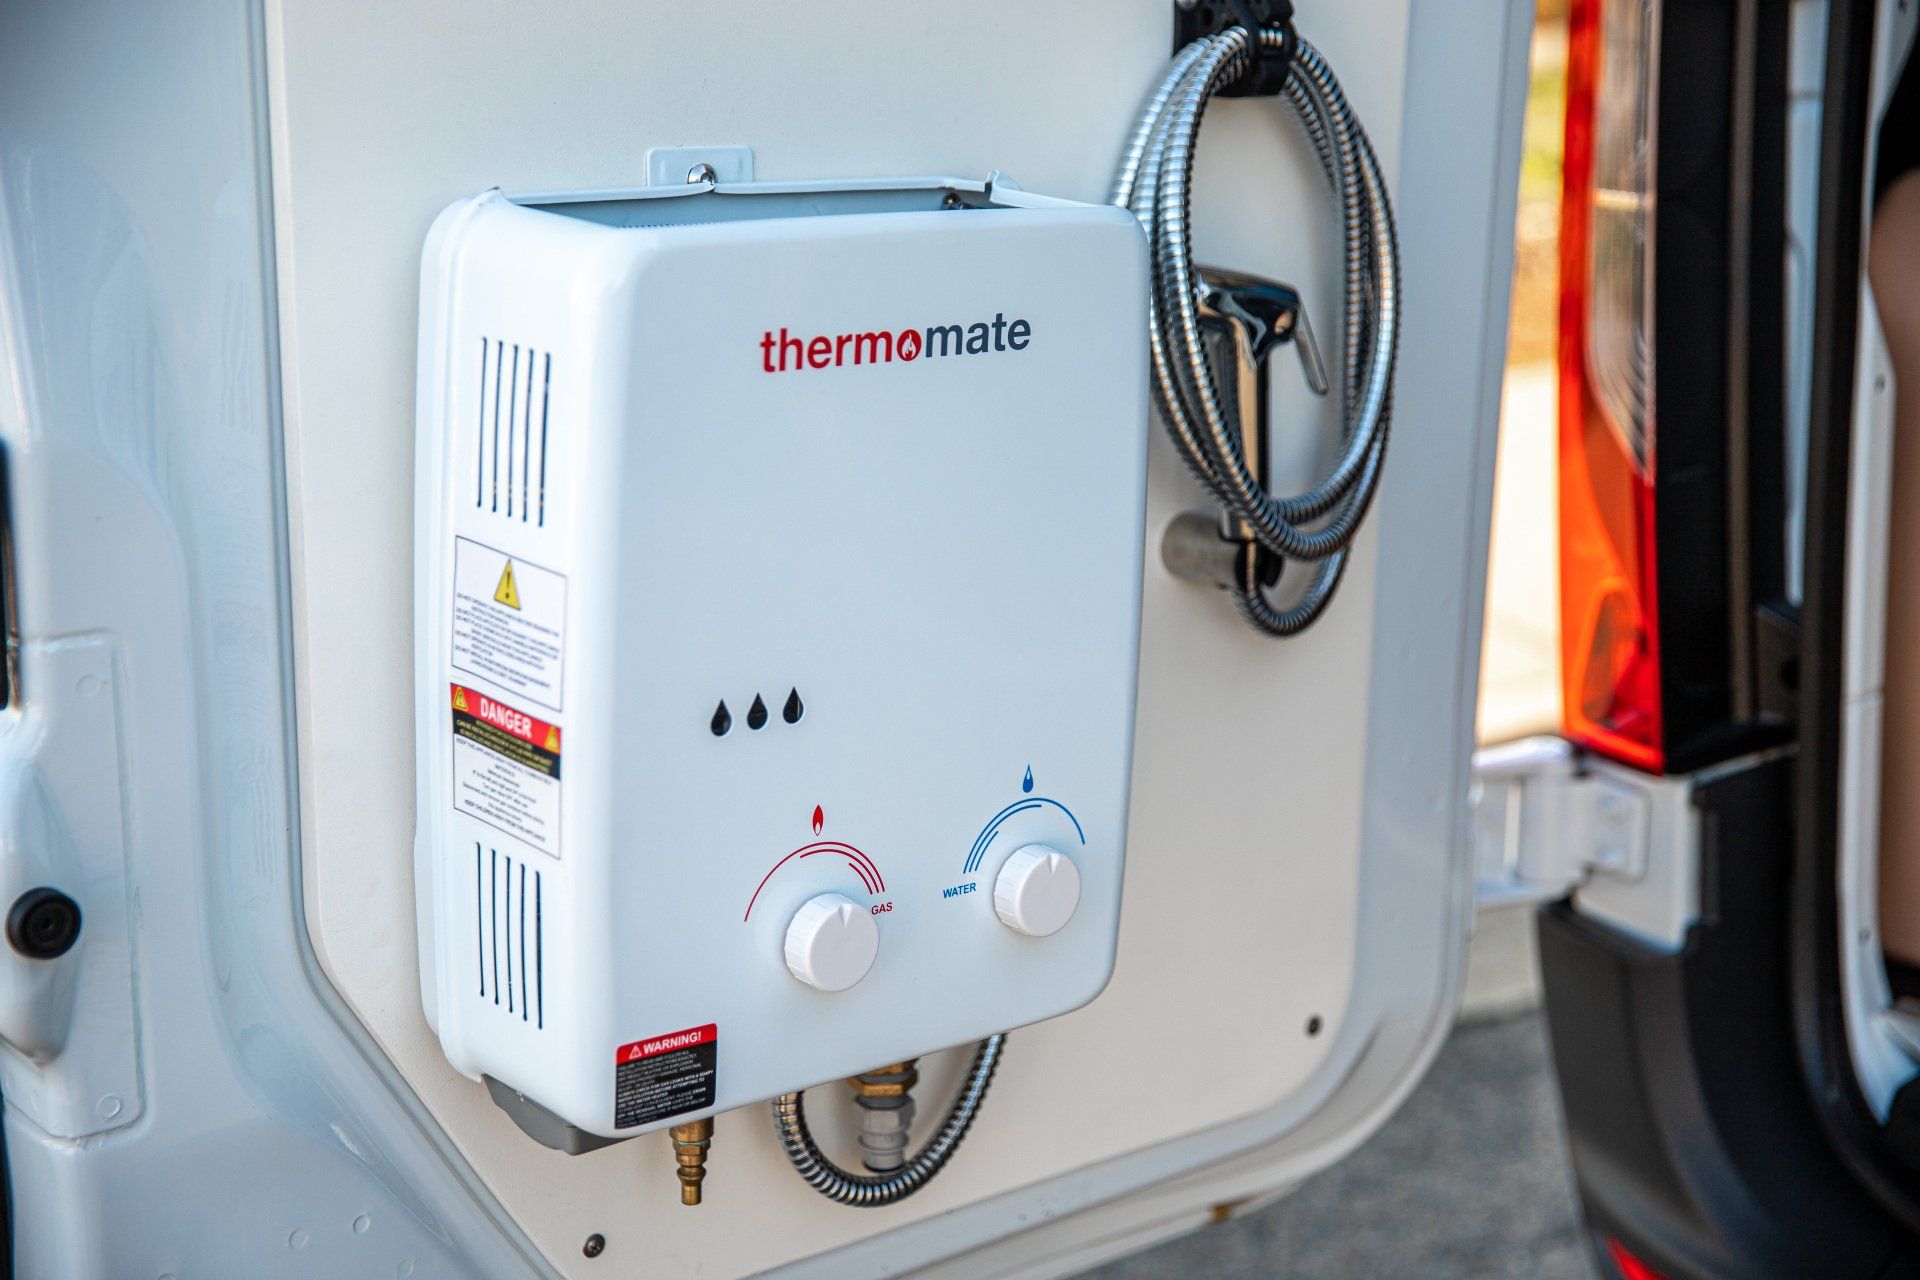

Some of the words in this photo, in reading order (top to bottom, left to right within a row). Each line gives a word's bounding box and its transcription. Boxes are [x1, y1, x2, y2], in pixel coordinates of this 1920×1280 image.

[760, 313, 1031, 372] thermomate
[480, 698, 532, 738] DANGER
[943, 882, 977, 898] WATER
[871, 902, 893, 915] GAS
[643, 1031, 702, 1054] WARNING!
